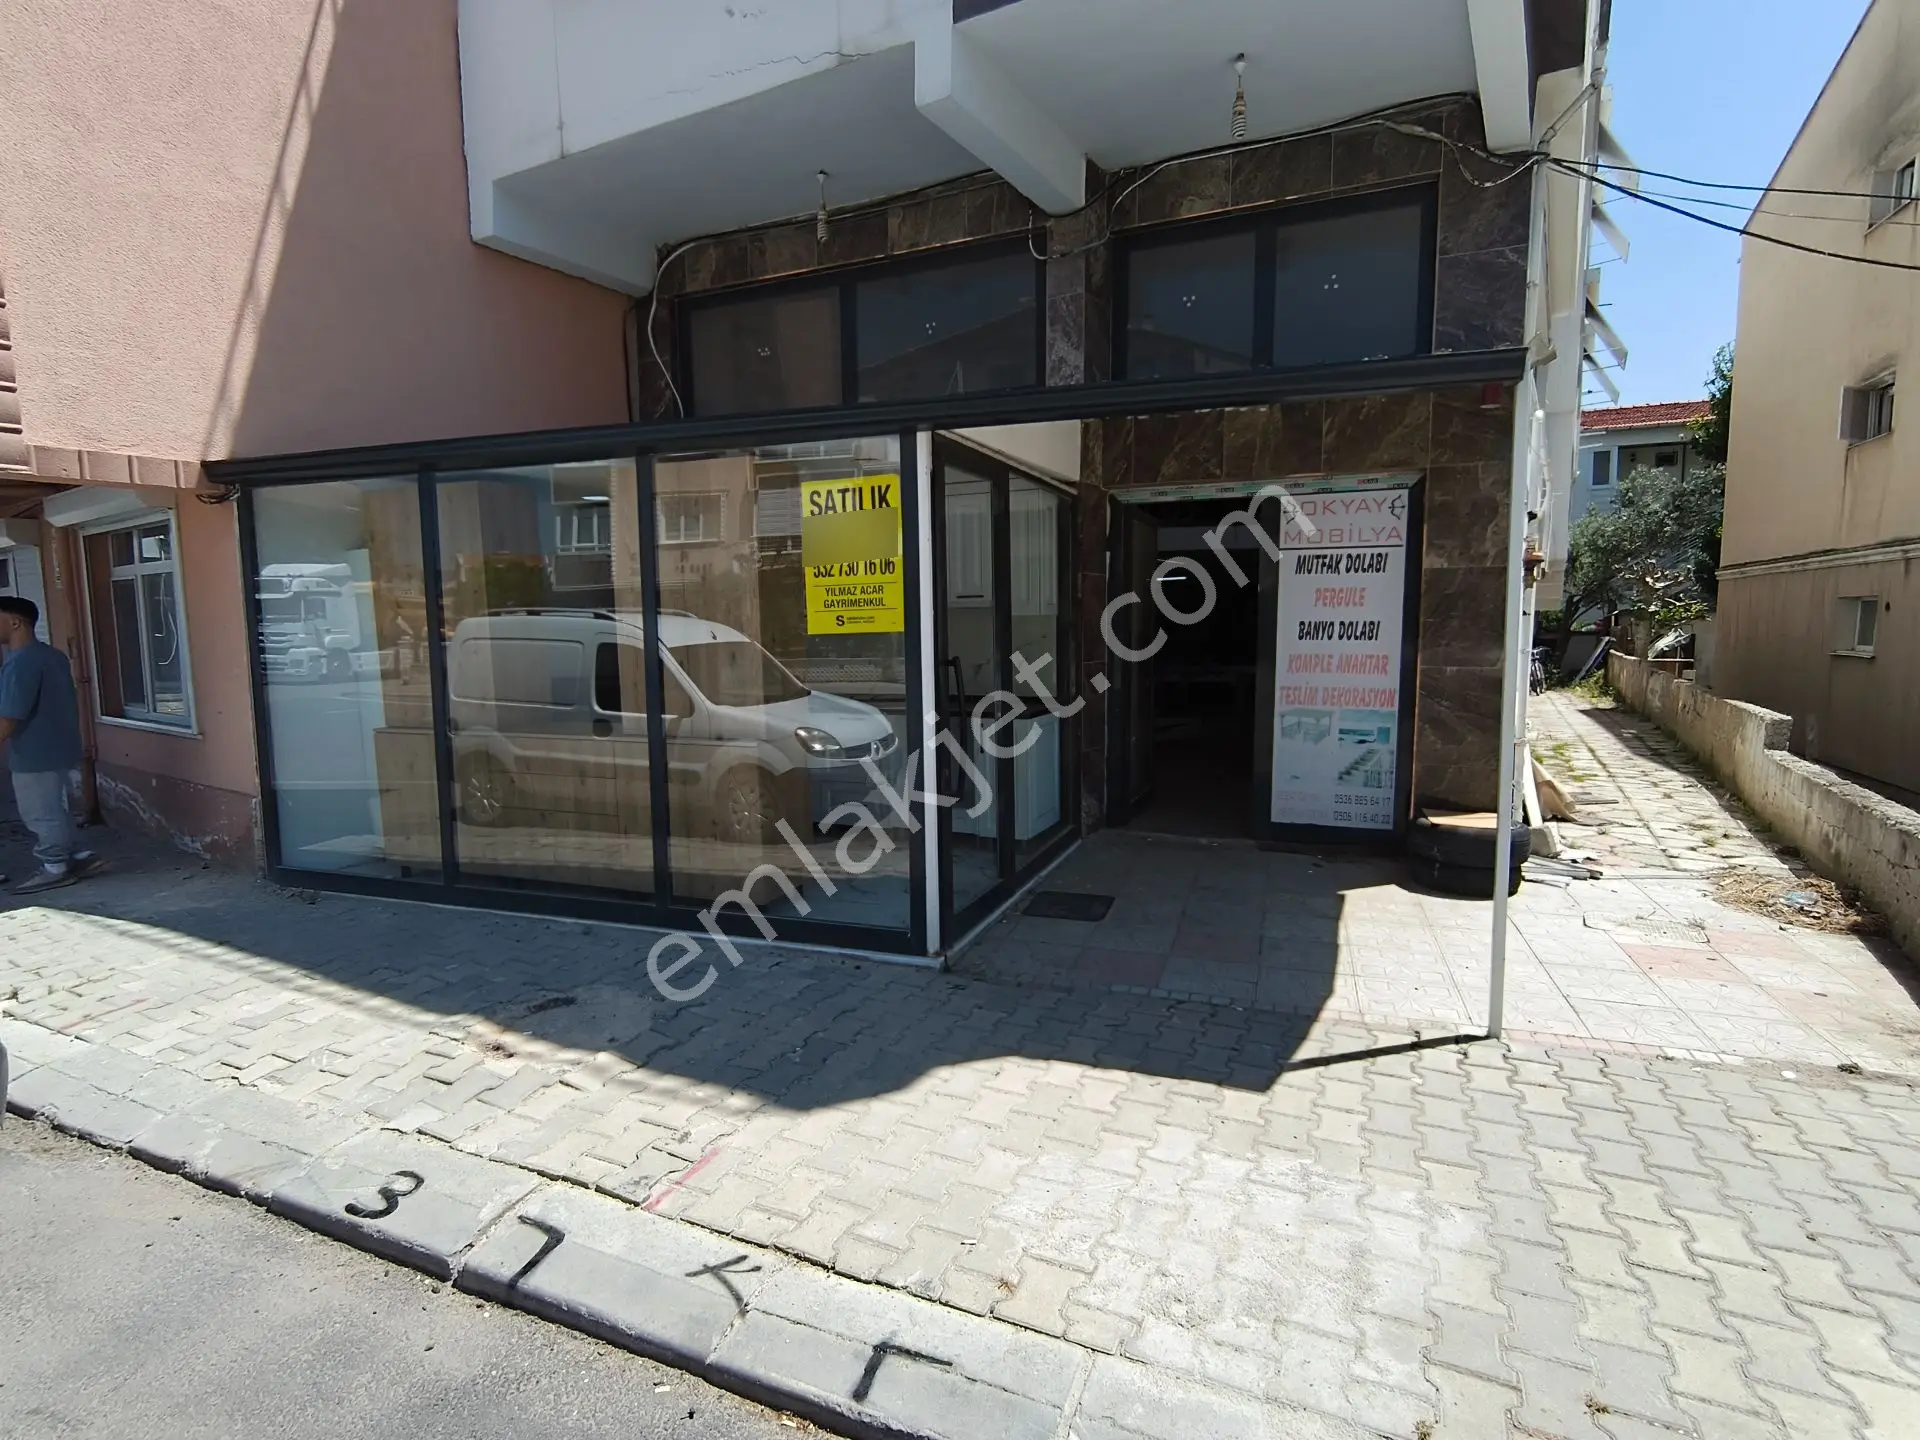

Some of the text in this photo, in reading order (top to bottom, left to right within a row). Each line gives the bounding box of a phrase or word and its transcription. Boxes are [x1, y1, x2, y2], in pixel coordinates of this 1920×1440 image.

[809, 484, 892, 517] SATILIK
[1295, 552, 1389, 575] MUTFAK DOLABI
[825, 585, 885, 597] YILMAZ ACAR
[823, 597, 887, 609] GAYRİMENKUL
[1298, 620, 1381, 641] BANYO DOLABI
[1287, 653, 1389, 676] KOMPLE ANAHTAR
[1321, 687, 1397, 708] DEKORASYON
